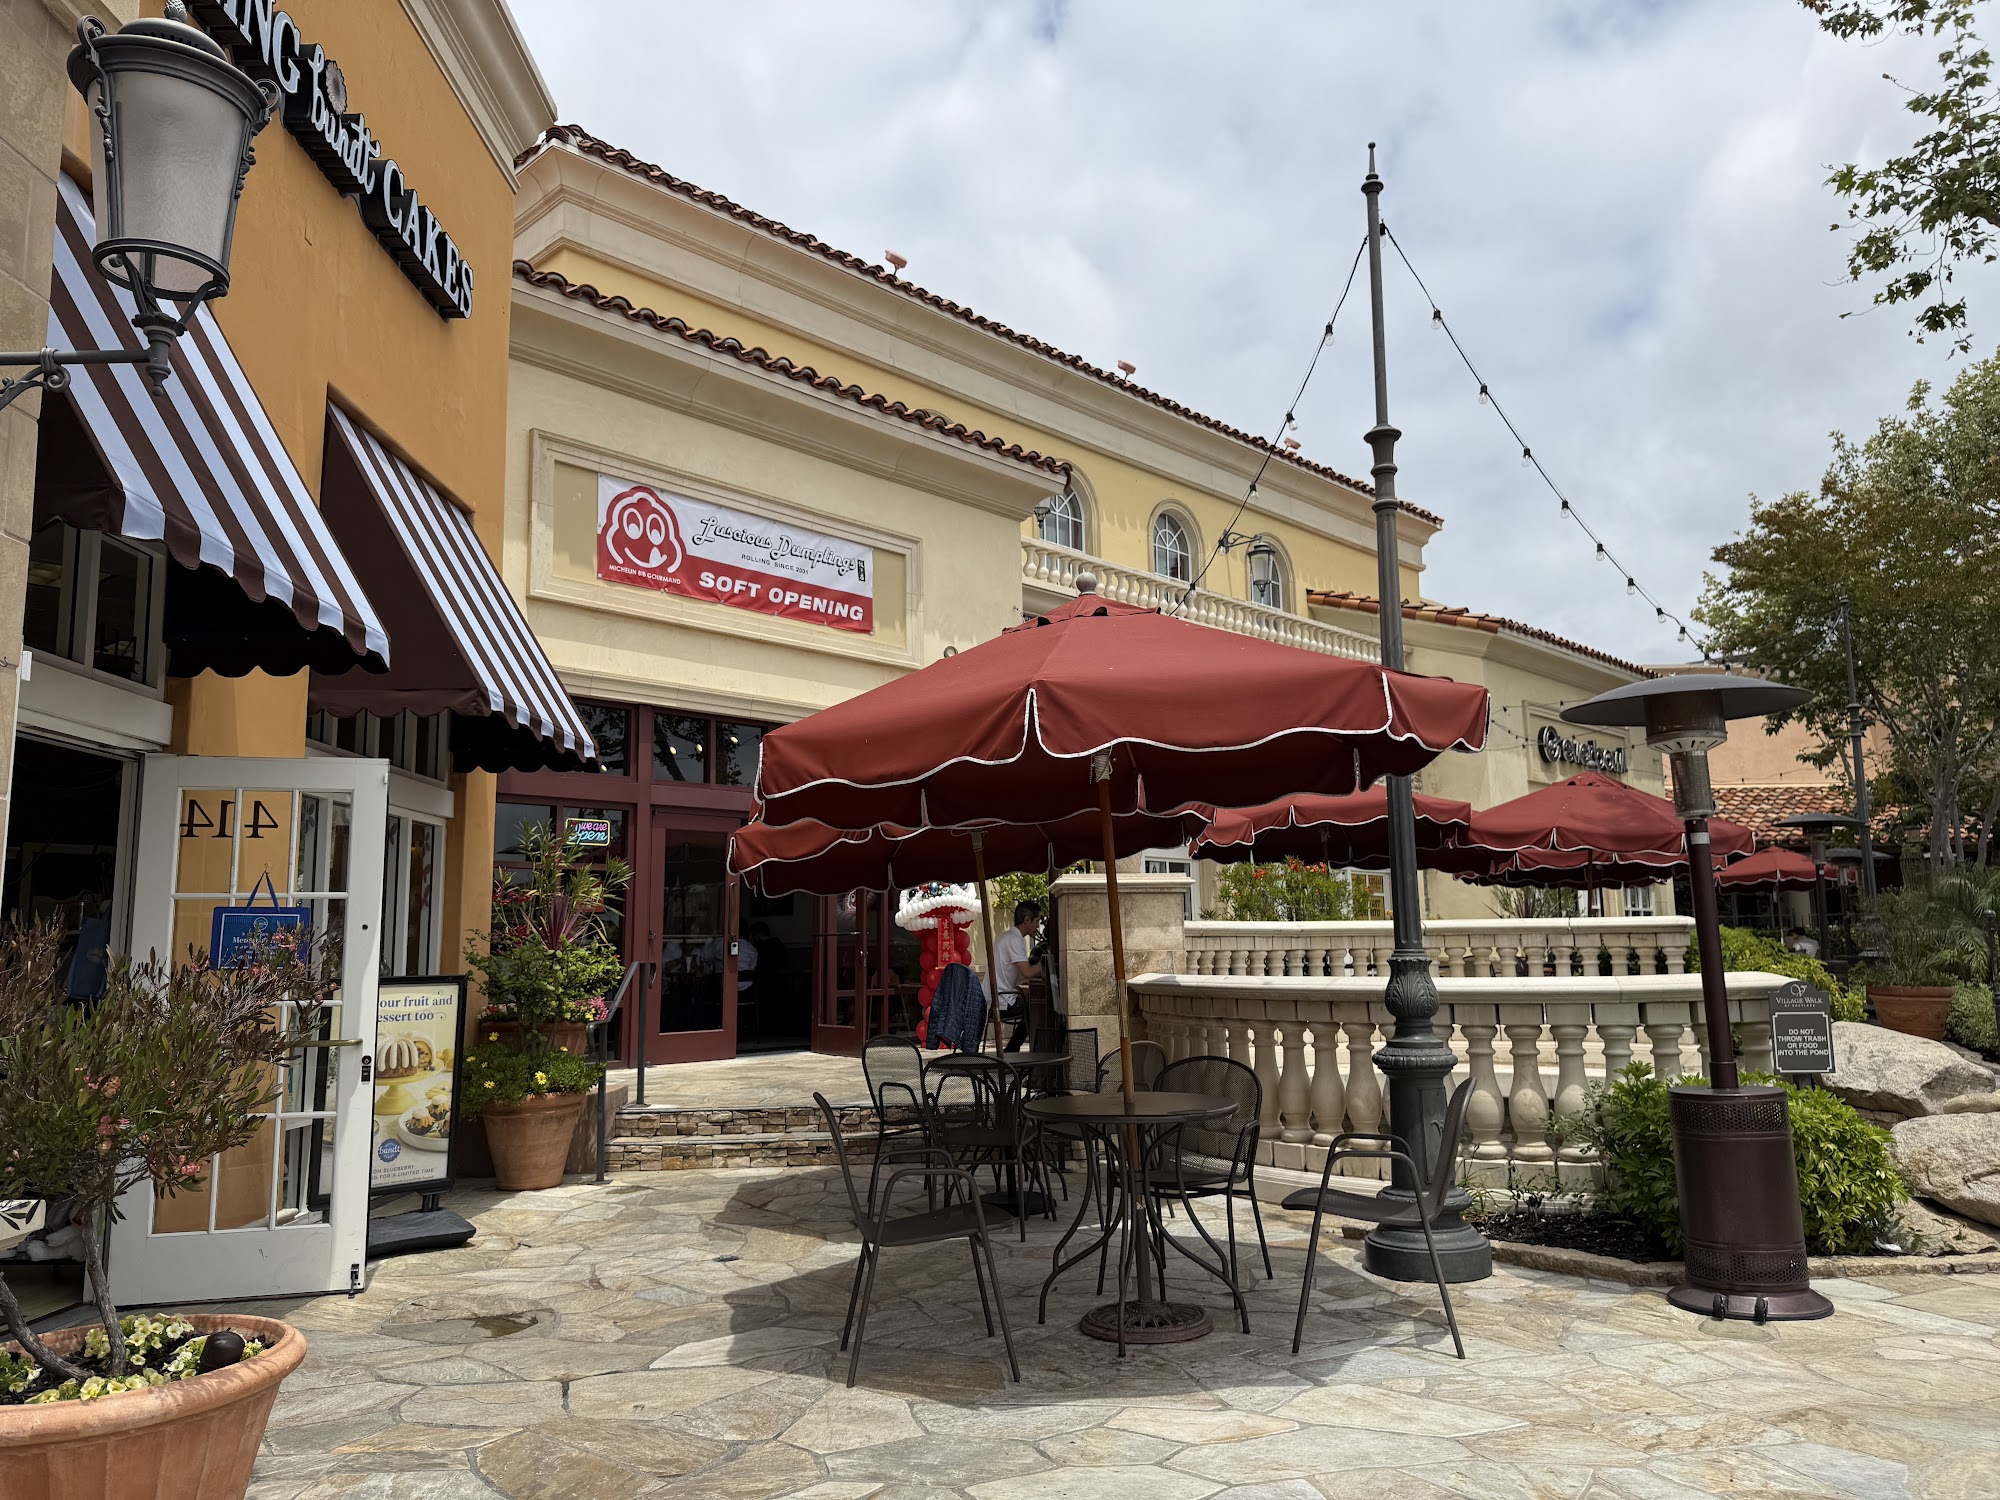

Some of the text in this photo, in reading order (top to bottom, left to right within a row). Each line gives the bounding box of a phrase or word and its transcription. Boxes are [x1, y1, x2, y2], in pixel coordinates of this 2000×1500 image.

[308, 43, 381, 195] bundt
[383, 159, 474, 319] CAKES
[692, 516, 773, 550] Luscious
[769, 534, 857, 577] Dumplings
[741, 553, 771, 566] ROLLING
[774, 561, 794, 571] SINCE
[608, 564, 637, 575] MICHELIN
[647, 572, 681, 585] GOURMAND
[698, 571, 864, 621] SOFT OPENING
[378, 994, 453, 1008] our fruit and
[1804, 996, 1823, 1004] WALK
[377, 1012, 435, 1023] essert too
[378, 1145, 400, 1155] bundt
[383, 1164, 415, 1173] BLUEBERRY
